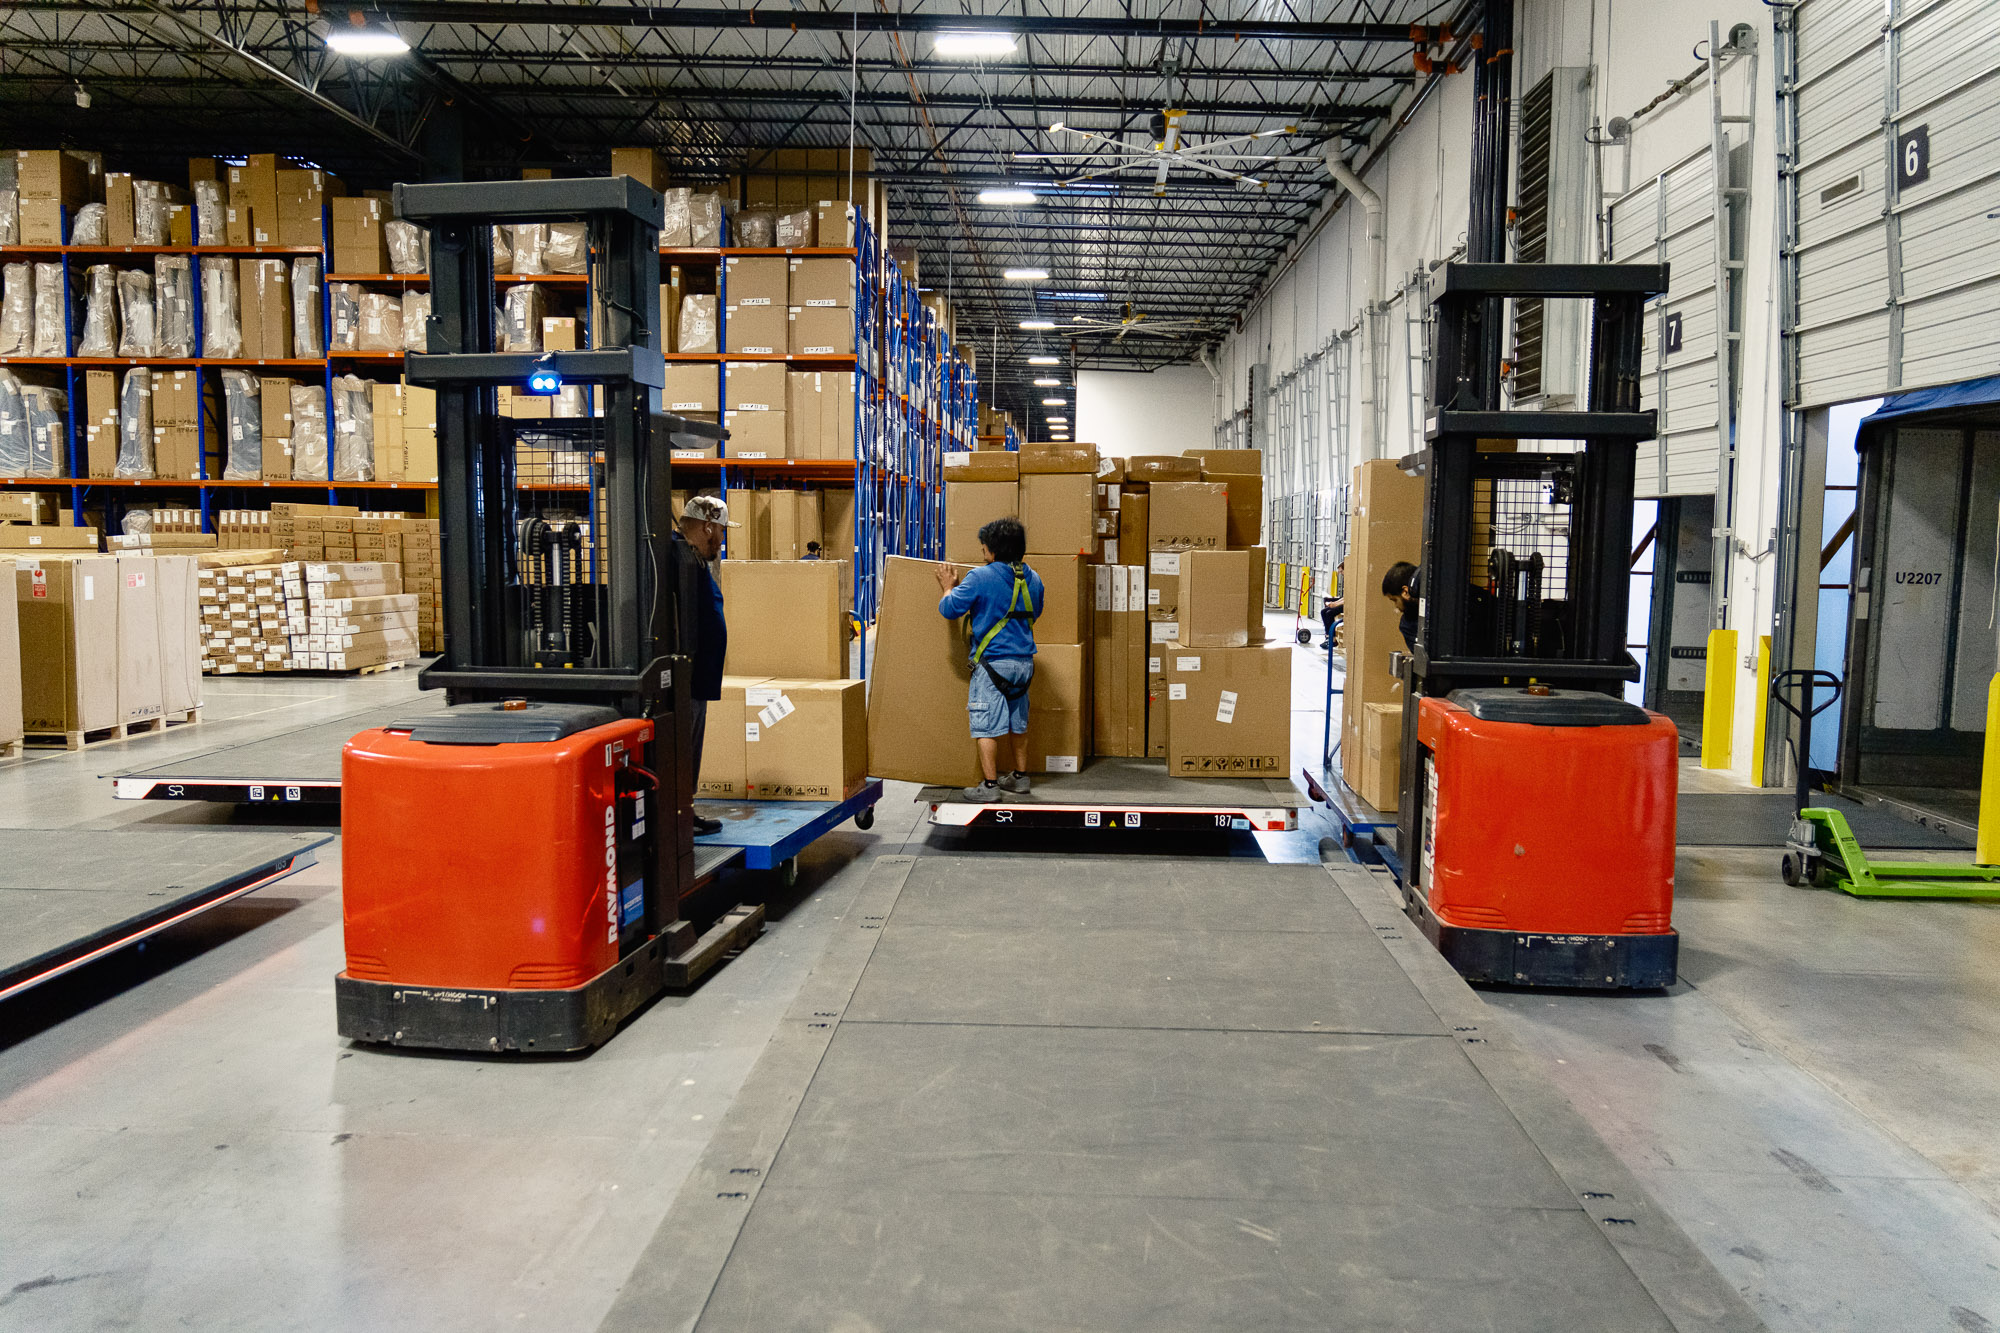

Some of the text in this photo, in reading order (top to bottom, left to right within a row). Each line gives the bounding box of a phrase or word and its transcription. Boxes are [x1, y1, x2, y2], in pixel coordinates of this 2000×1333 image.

[1905, 139, 1919, 177] 6
[1669, 320, 1677, 347] 7
[1895, 571, 1942, 585] U2207
[1267, 757, 1275, 767] 3
[168, 784, 185, 797] SR
[996, 810, 1014, 823] SR
[1214, 814, 1232, 827] 187
[604, 804, 618, 945] RAYMOND
